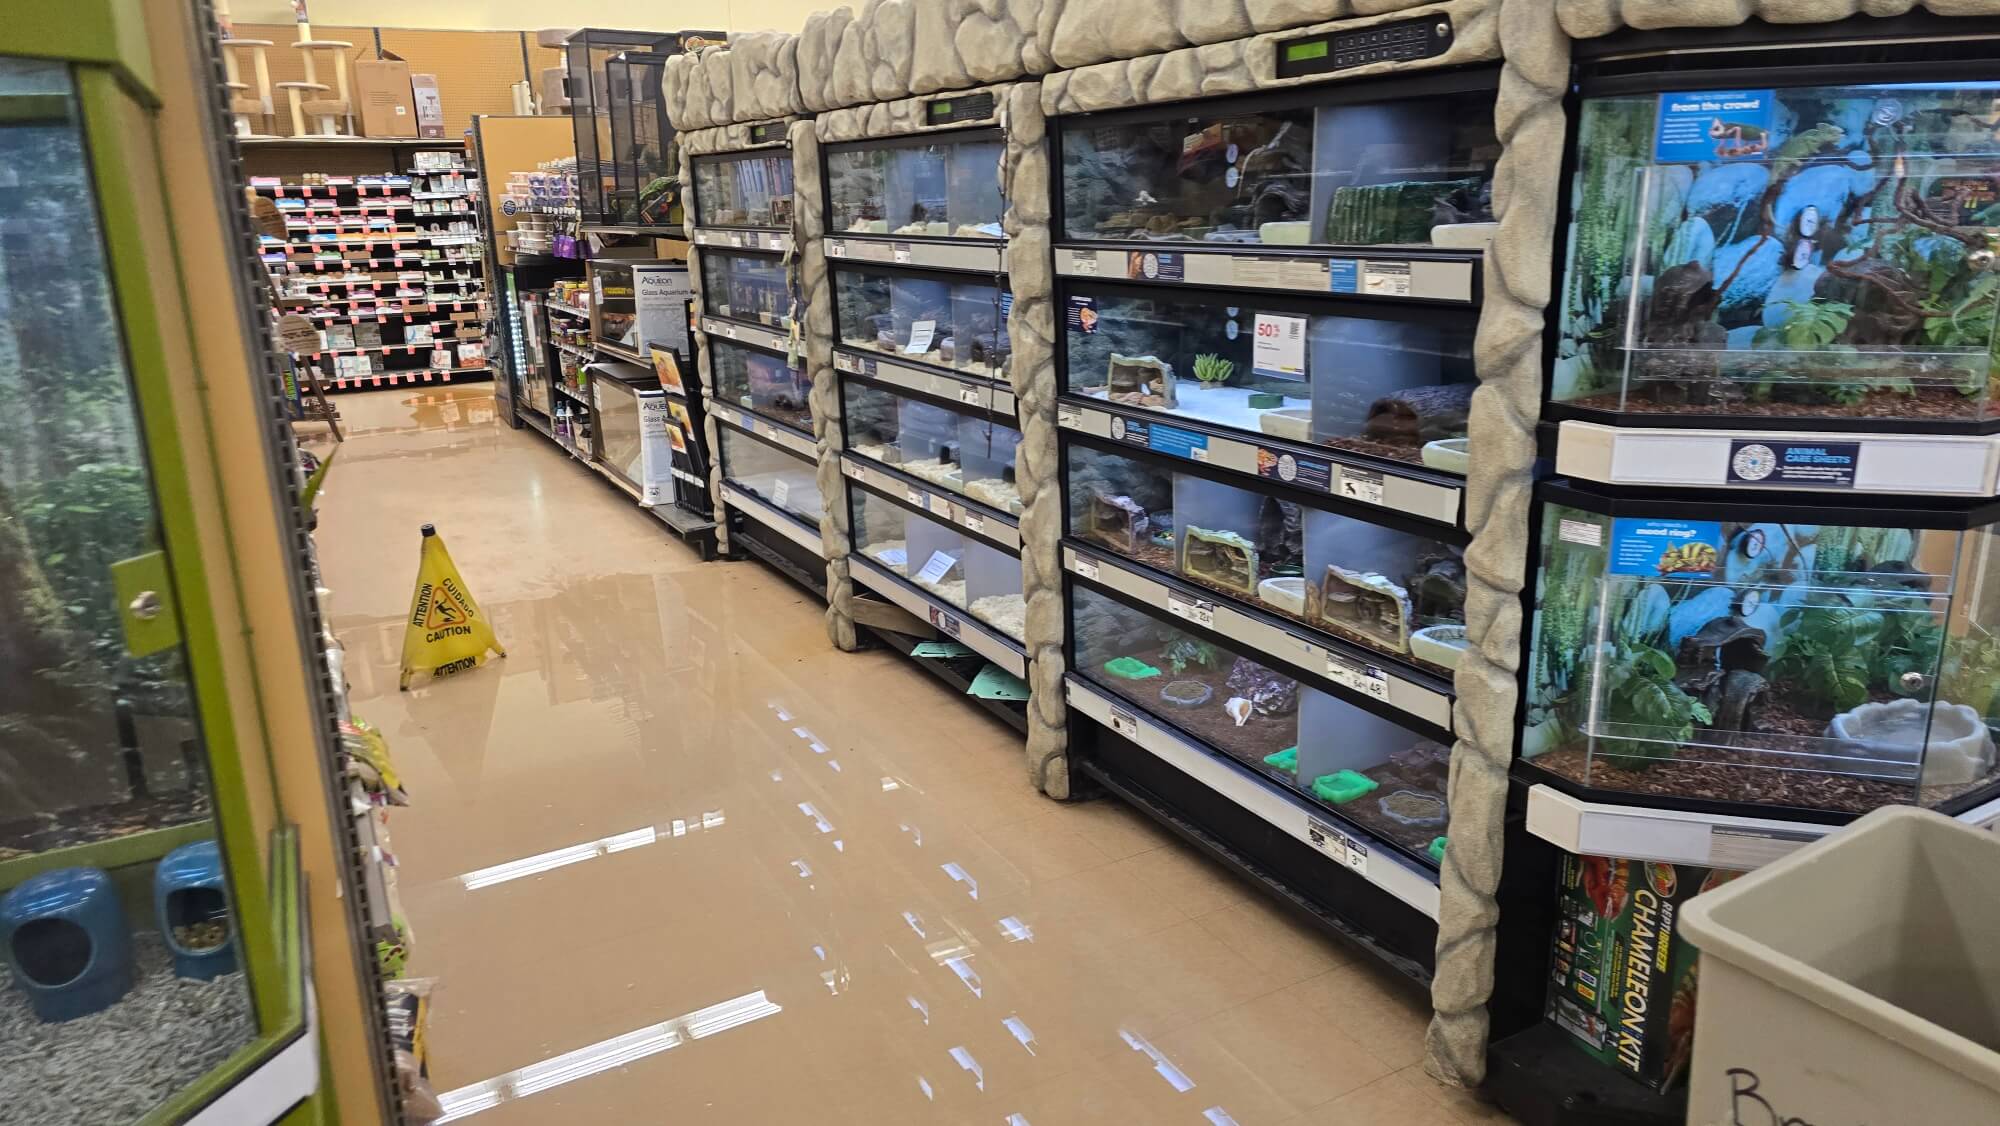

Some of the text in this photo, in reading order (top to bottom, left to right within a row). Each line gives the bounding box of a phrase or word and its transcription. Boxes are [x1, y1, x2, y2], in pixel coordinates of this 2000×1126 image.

[1671, 99, 1760, 112] from the crowd
[659, 289, 689, 297] Aquarium
[1258, 323, 1273, 337] 50
[1785, 447, 1828, 455] ANIMAL
[1785, 455, 1851, 464] CARE SHEETS
[1636, 528, 1697, 538] mood ring?
[442, 578, 475, 618] CUIDADO
[412, 583, 433, 628] ATTENTION
[426, 625, 472, 643] CAUTION
[433, 655, 477, 677] ATTENTION
[1618, 889, 1658, 1073] CHAMELEON KIT
